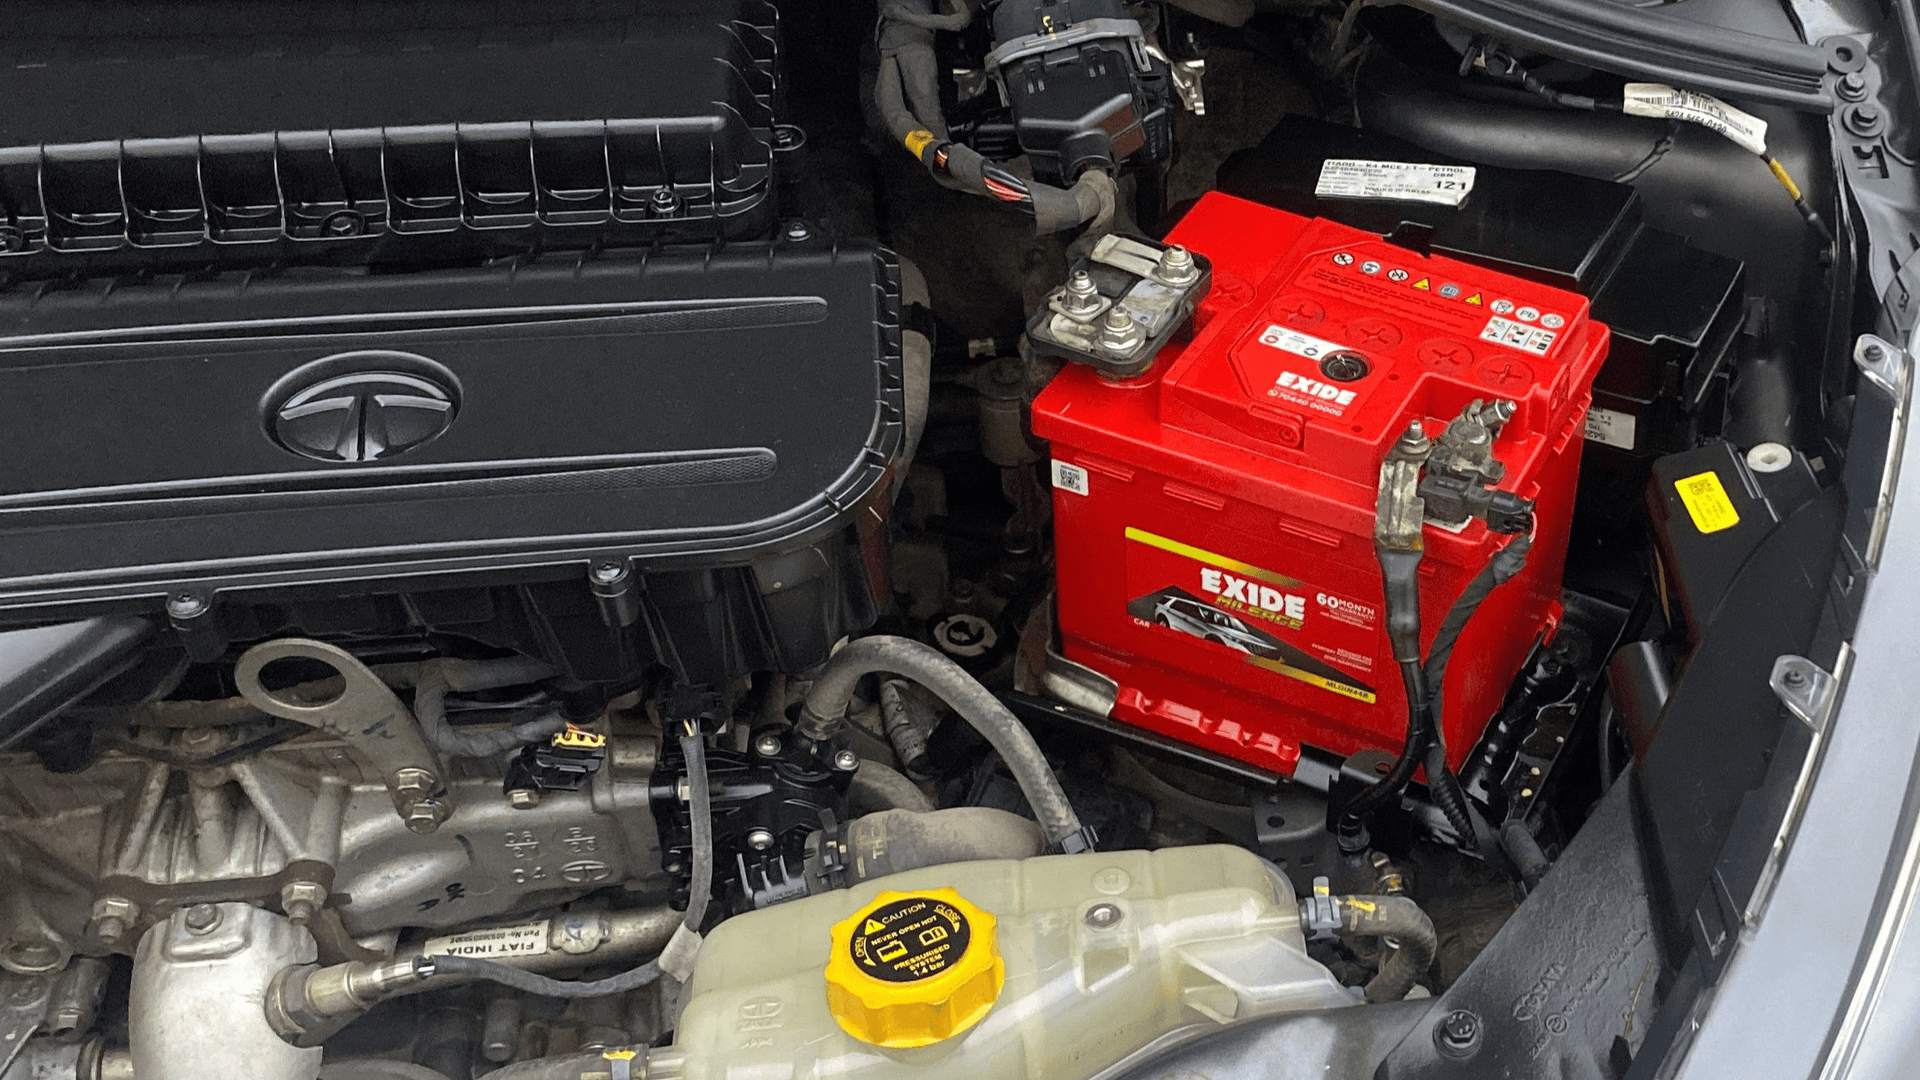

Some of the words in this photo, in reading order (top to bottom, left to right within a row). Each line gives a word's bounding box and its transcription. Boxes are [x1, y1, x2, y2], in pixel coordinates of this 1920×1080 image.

[1428, 166, 1466, 174] PETROL
[1434, 180, 1467, 190] 121
[1520, 309, 1536, 319] Pb
[1275, 371, 1358, 406] EXIDE
[1200, 567, 1306, 620] EXIDE
[1215, 595, 1304, 630] MILEAGE
[1316, 592, 1339, 609] 60
[1338, 598, 1375, 616] MONTH
[1133, 617, 1151, 629] CAR
[882, 902, 927, 924] CAUTION
[936, 904, 962, 924] CLOSE
[871, 932, 898, 946] NEVER
[898, 922, 921, 935] OPEN
[921, 915, 938, 926] HOT
[446, 945, 492, 956] INDIA
[498, 942, 535, 952] FIAT
[854, 936, 865, 958] OPEN
[893, 944, 950, 971] PRESSURISED
[910, 954, 943, 972] SYSTEM
[914, 966, 928, 977] 1.4
[928, 960, 945, 971] bar
